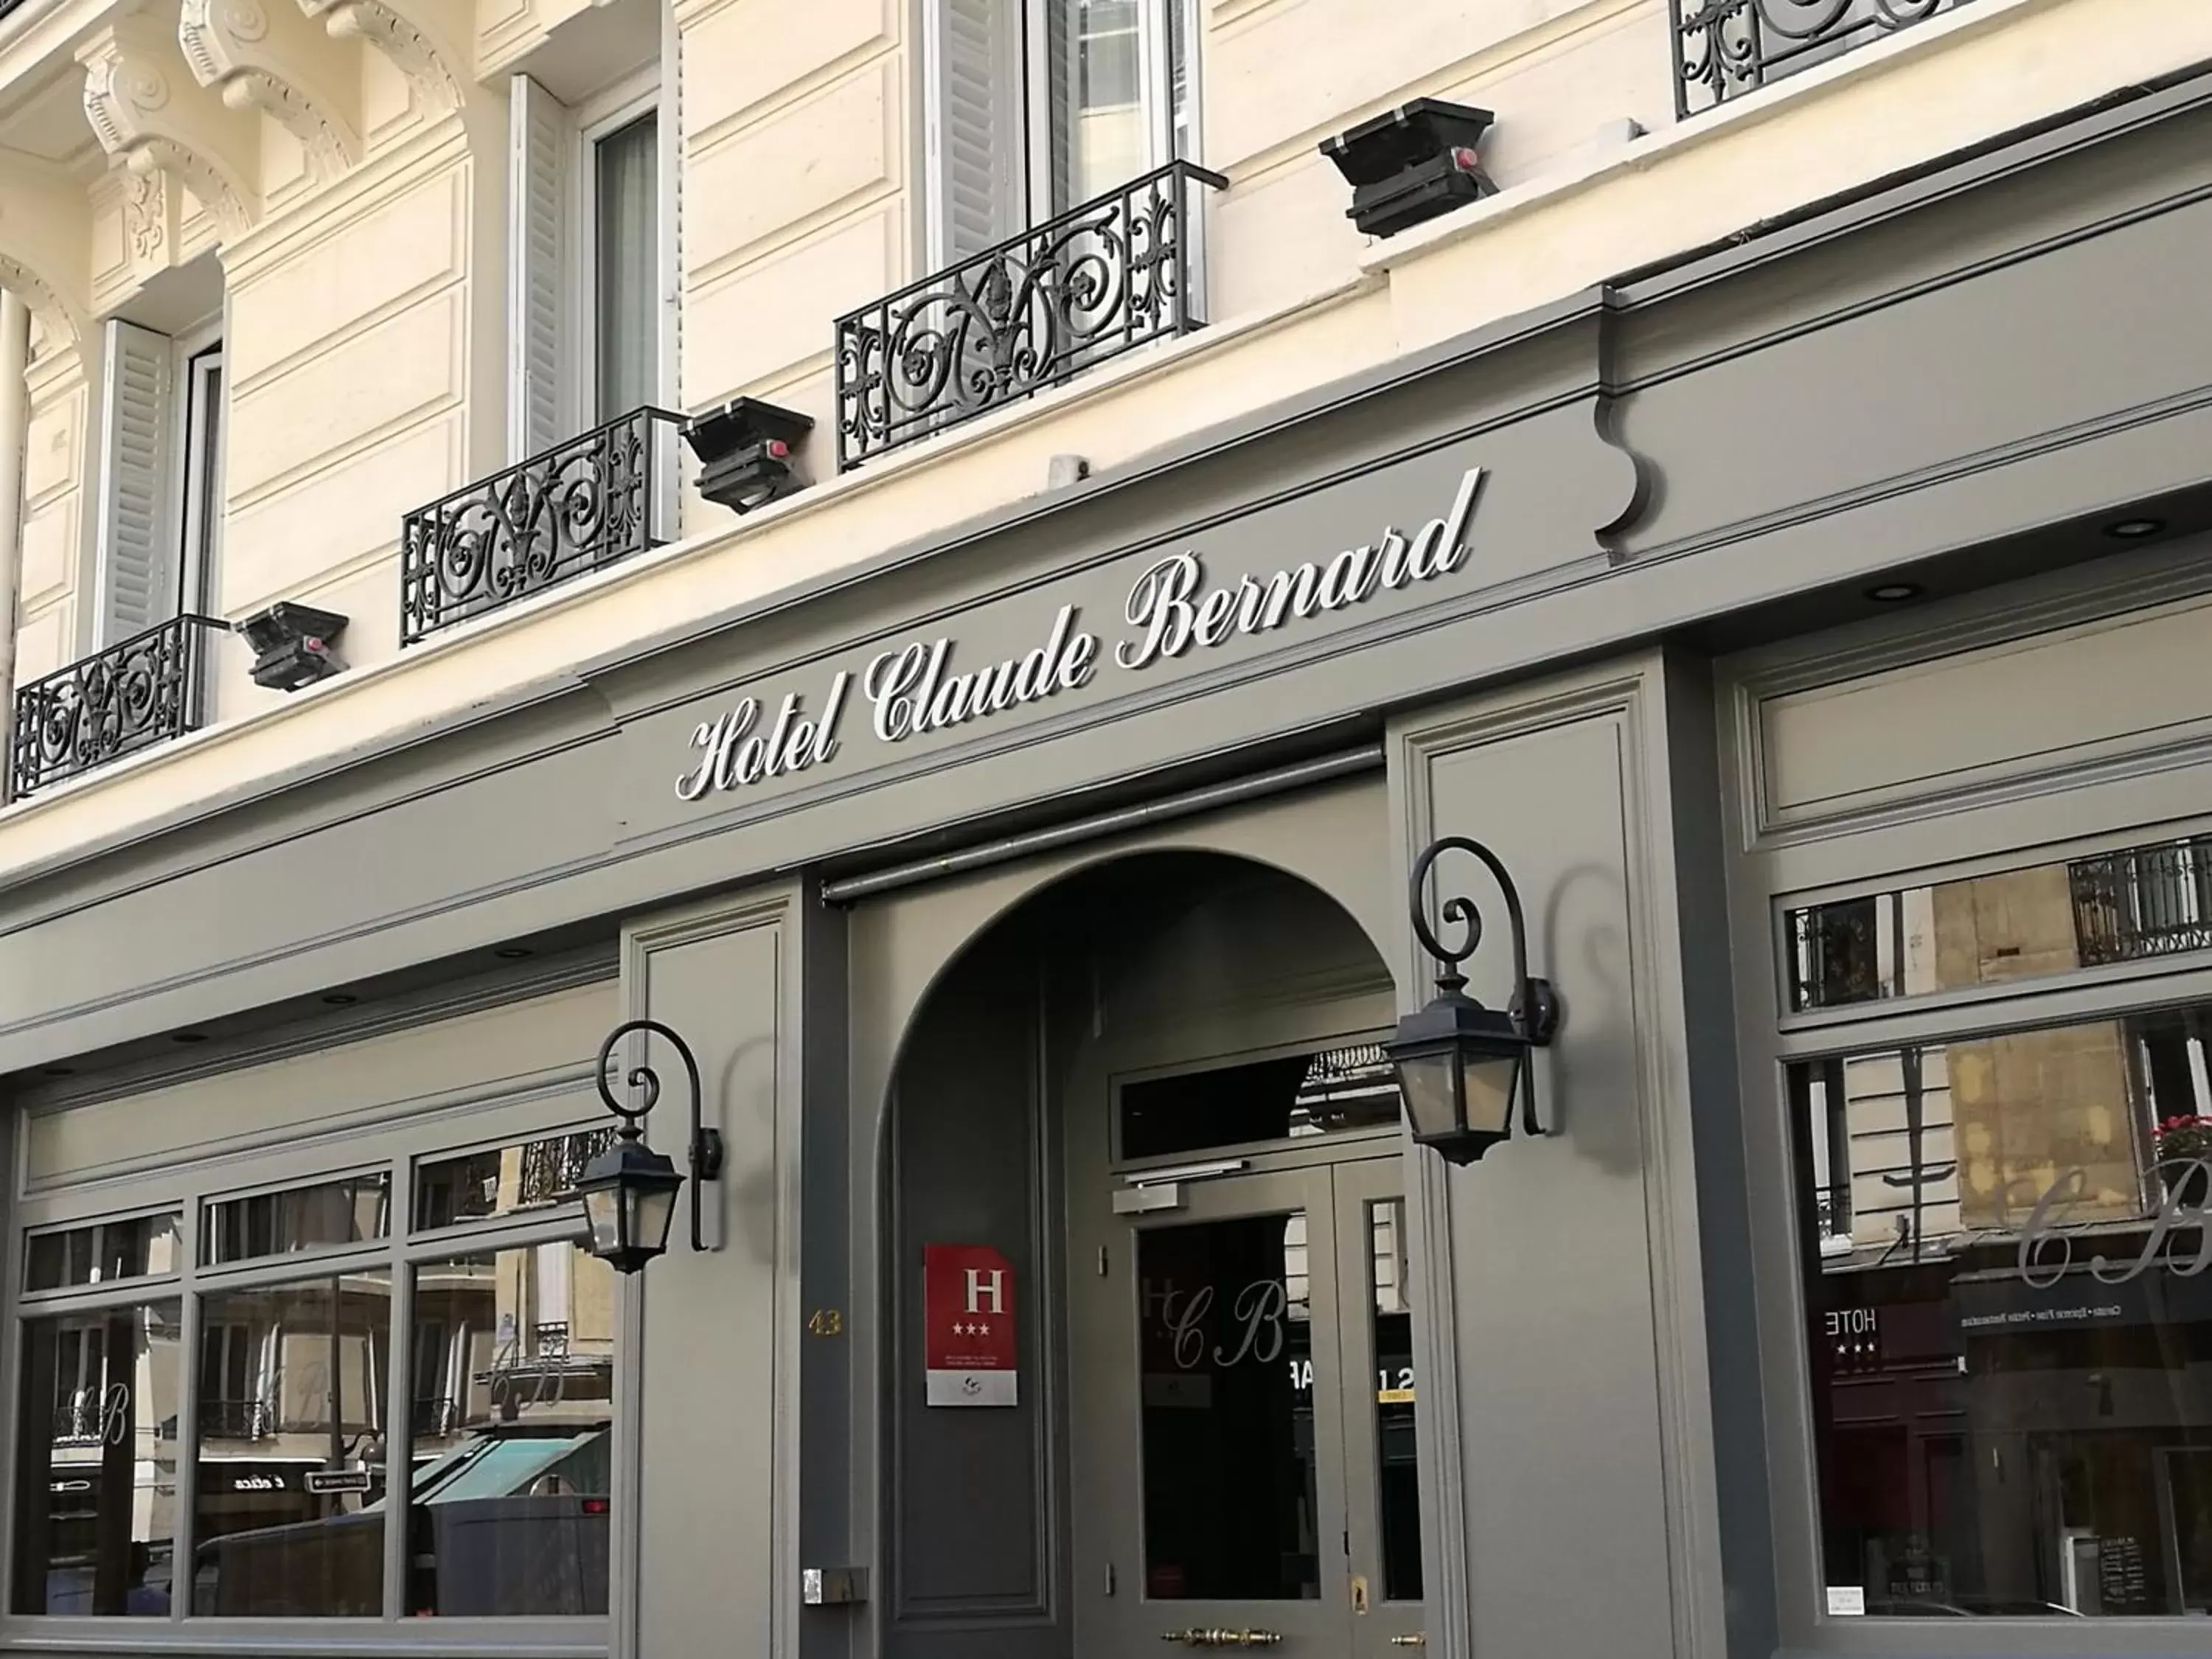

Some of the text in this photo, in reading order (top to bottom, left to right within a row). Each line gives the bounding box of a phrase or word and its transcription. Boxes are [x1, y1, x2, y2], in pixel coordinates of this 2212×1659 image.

[675, 467, 1481, 801] Hotel Claude Bernard
[963, 1268, 1006, 1313] H
[809, 1309, 842, 1335] 43
